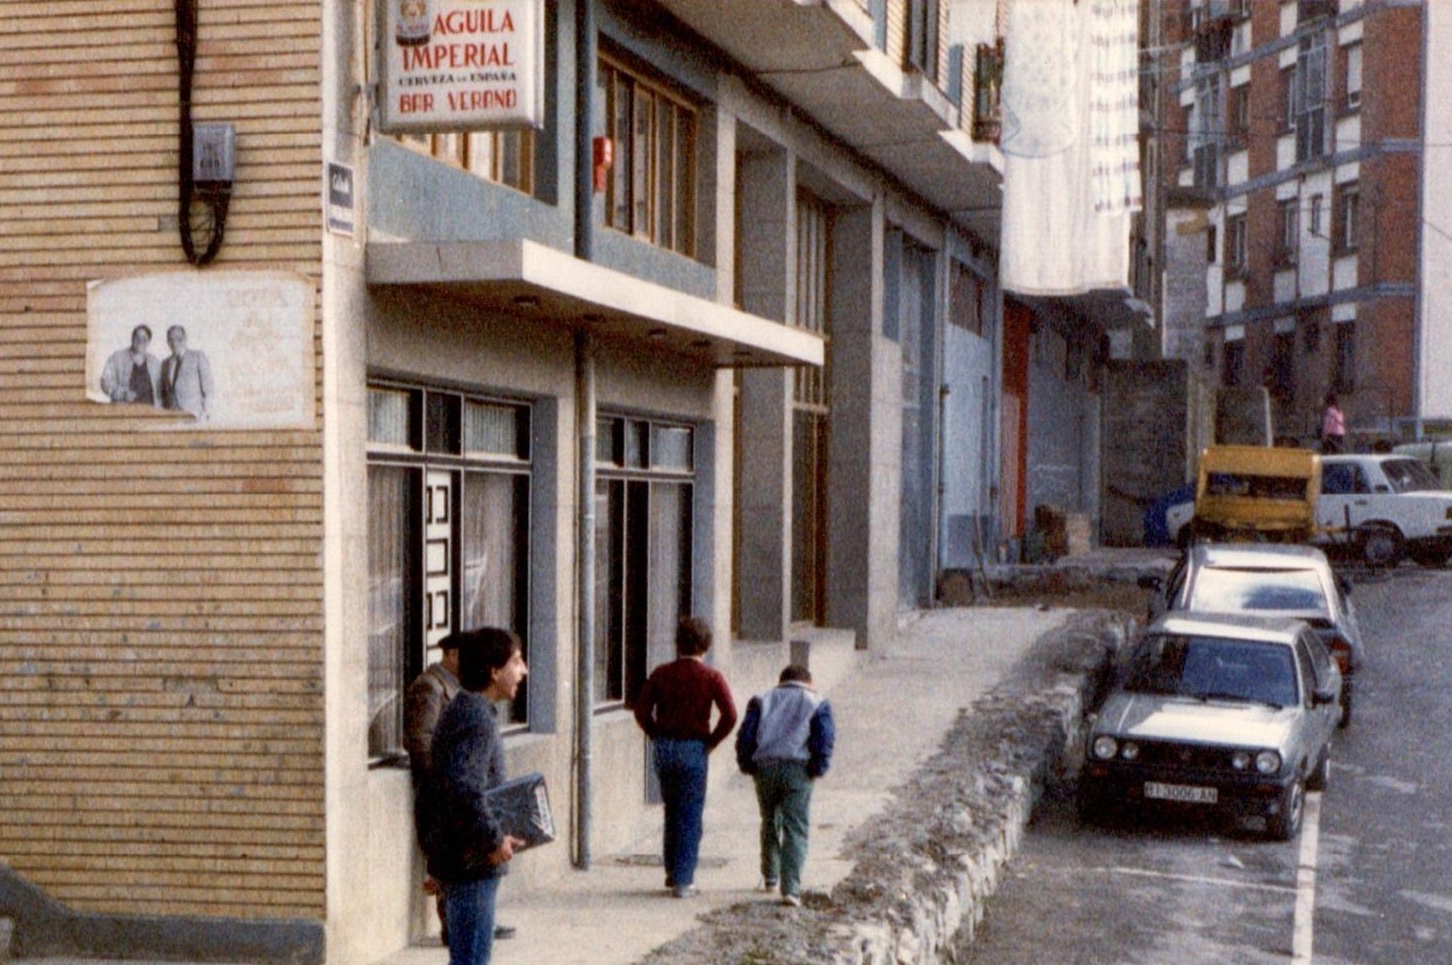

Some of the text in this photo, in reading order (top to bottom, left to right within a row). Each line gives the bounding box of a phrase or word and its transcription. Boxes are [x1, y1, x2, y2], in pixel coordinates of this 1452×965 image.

[432, 9, 515, 36] AGUILA
[402, 42, 515, 71] IMPERIAL
[398, 73, 454, 87] CERVEZA
[470, 71, 517, 82] ESPAÑA
[400, 93, 434, 114] BAR
